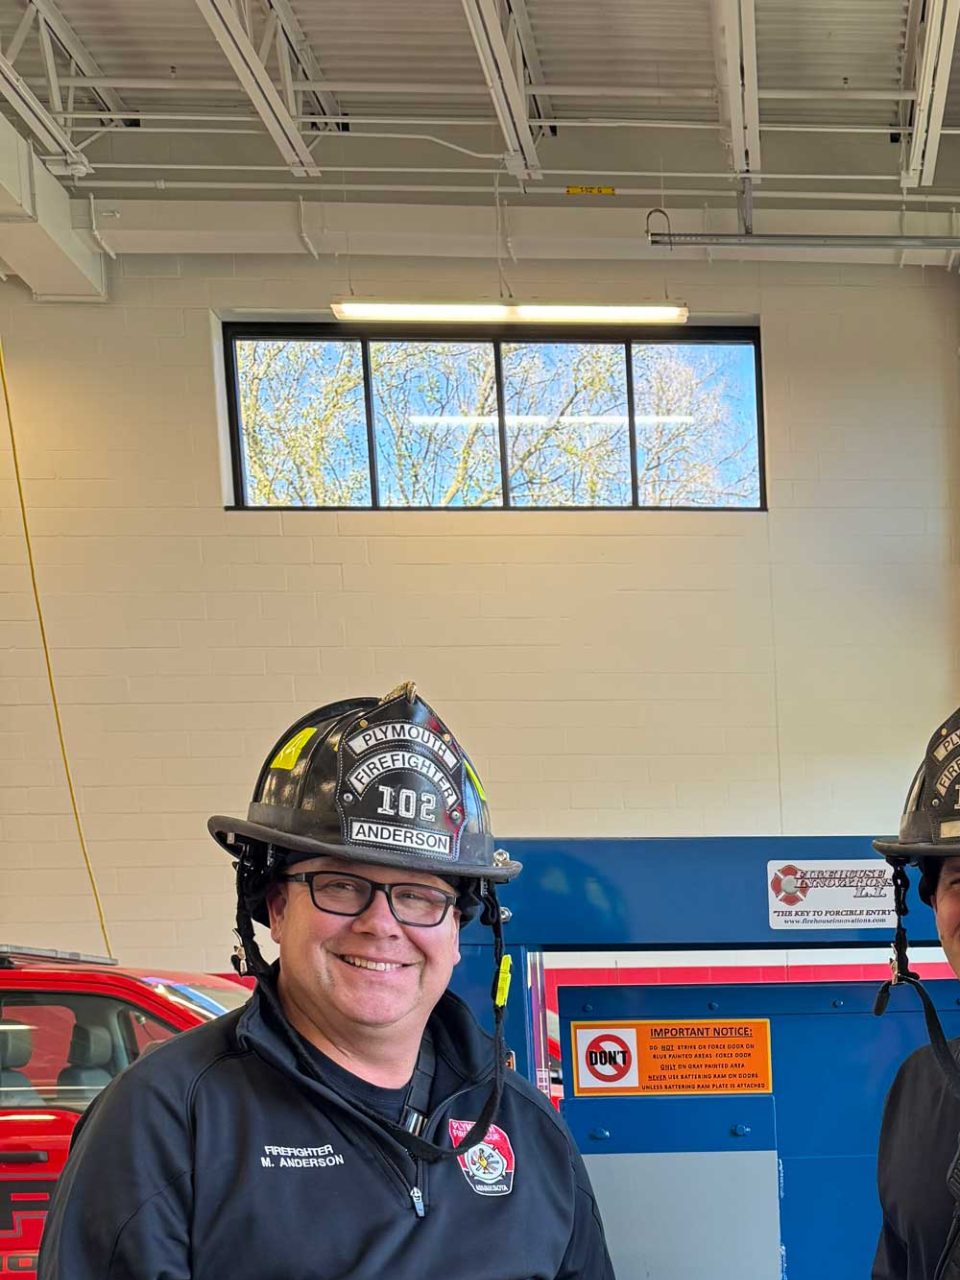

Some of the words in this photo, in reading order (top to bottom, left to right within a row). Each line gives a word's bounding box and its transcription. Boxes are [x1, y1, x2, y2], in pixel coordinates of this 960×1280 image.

[362, 722, 448, 757] PLYMOUTH
[354, 752, 455, 801] FIREFIGHTER
[376, 784, 437, 822] 102
[355, 823, 448, 851] ANDERSON
[650, 1027, 710, 1038] IMPORTANT
[713, 1027, 753, 1037] NOTICE:
[589, 1051, 628, 1066] DON'T
[260, 1156, 275, 1167] M.
[279, 1154, 345, 1168] ANDERSON
[264, 1144, 334, 1157] FIREFIGHTER
